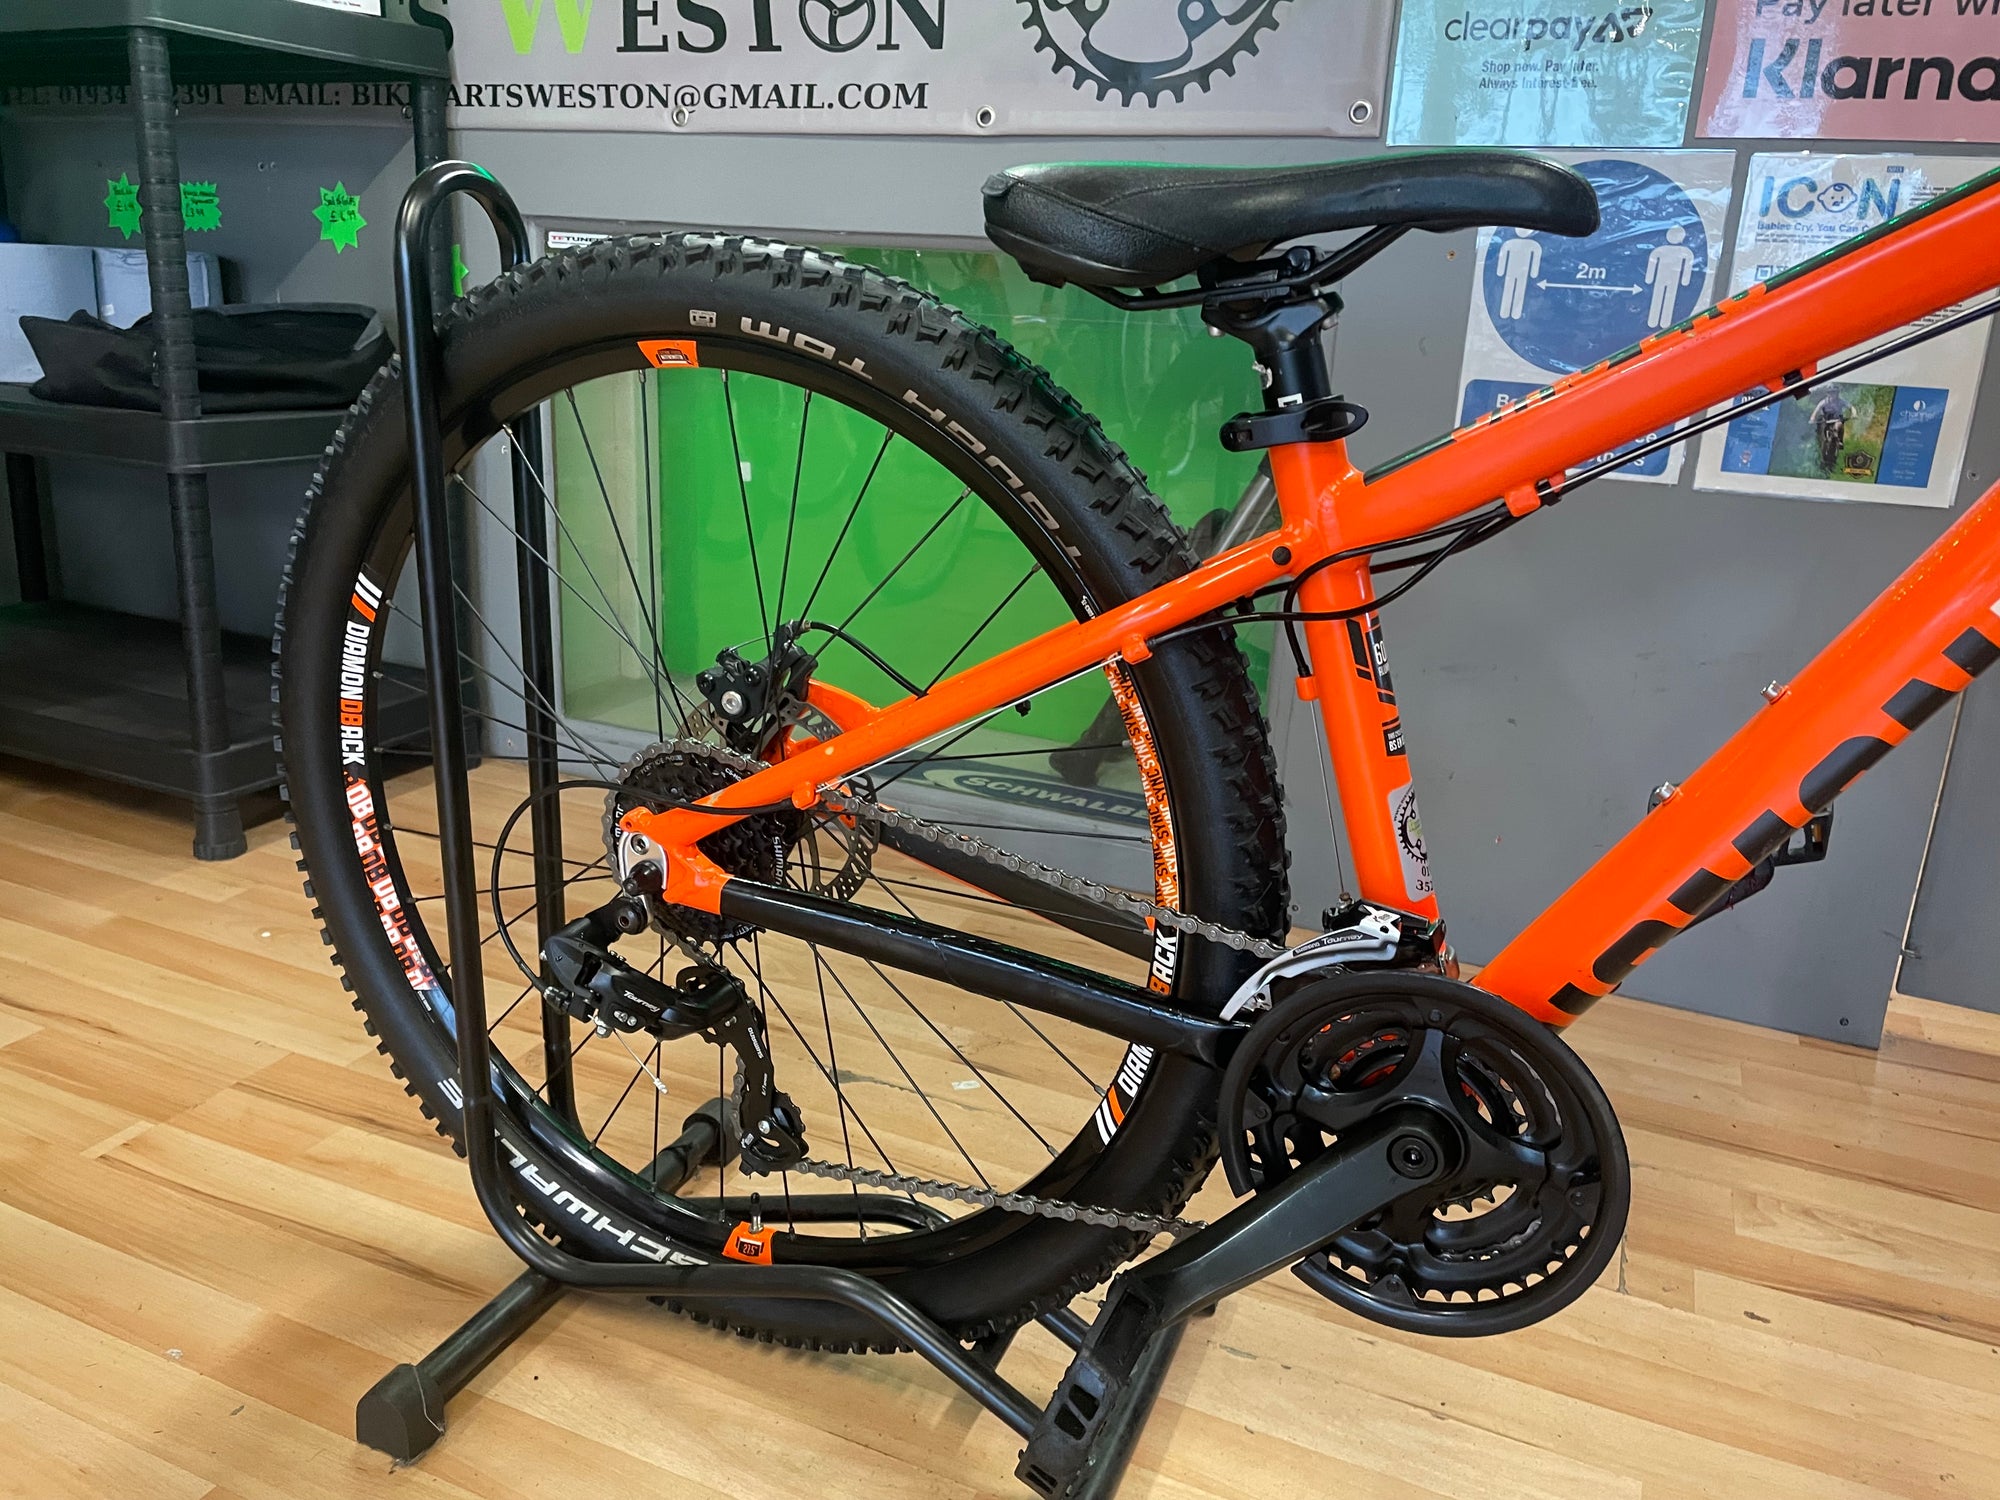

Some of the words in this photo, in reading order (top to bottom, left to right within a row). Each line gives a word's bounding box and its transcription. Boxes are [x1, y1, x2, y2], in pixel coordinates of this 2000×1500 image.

[1841, 0, 1932, 17] later
[1444, 11, 1596, 51] clearpay
[1481, 60, 1511, 75] Shop
[1742, 38, 2000, 102] Klarna
[243, 83, 341, 106] EMAIL:
[352, 82, 929, 112] BIKARTSWESTON@GMAIL.COM
[1479, 77, 1518, 91] Always
[1839, 224, 1859, 233] Can
[1576, 262, 1607, 280] 2m
[741, 316, 873, 379] TOM
[340, 620, 371, 766] DIAMONDBACK
[772, 836, 784, 885] SHIMAN
[1321, 934, 1364, 946] Tourney
[623, 990, 661, 1013] Tourney
[432, 1078, 709, 1265] SCHWALE
